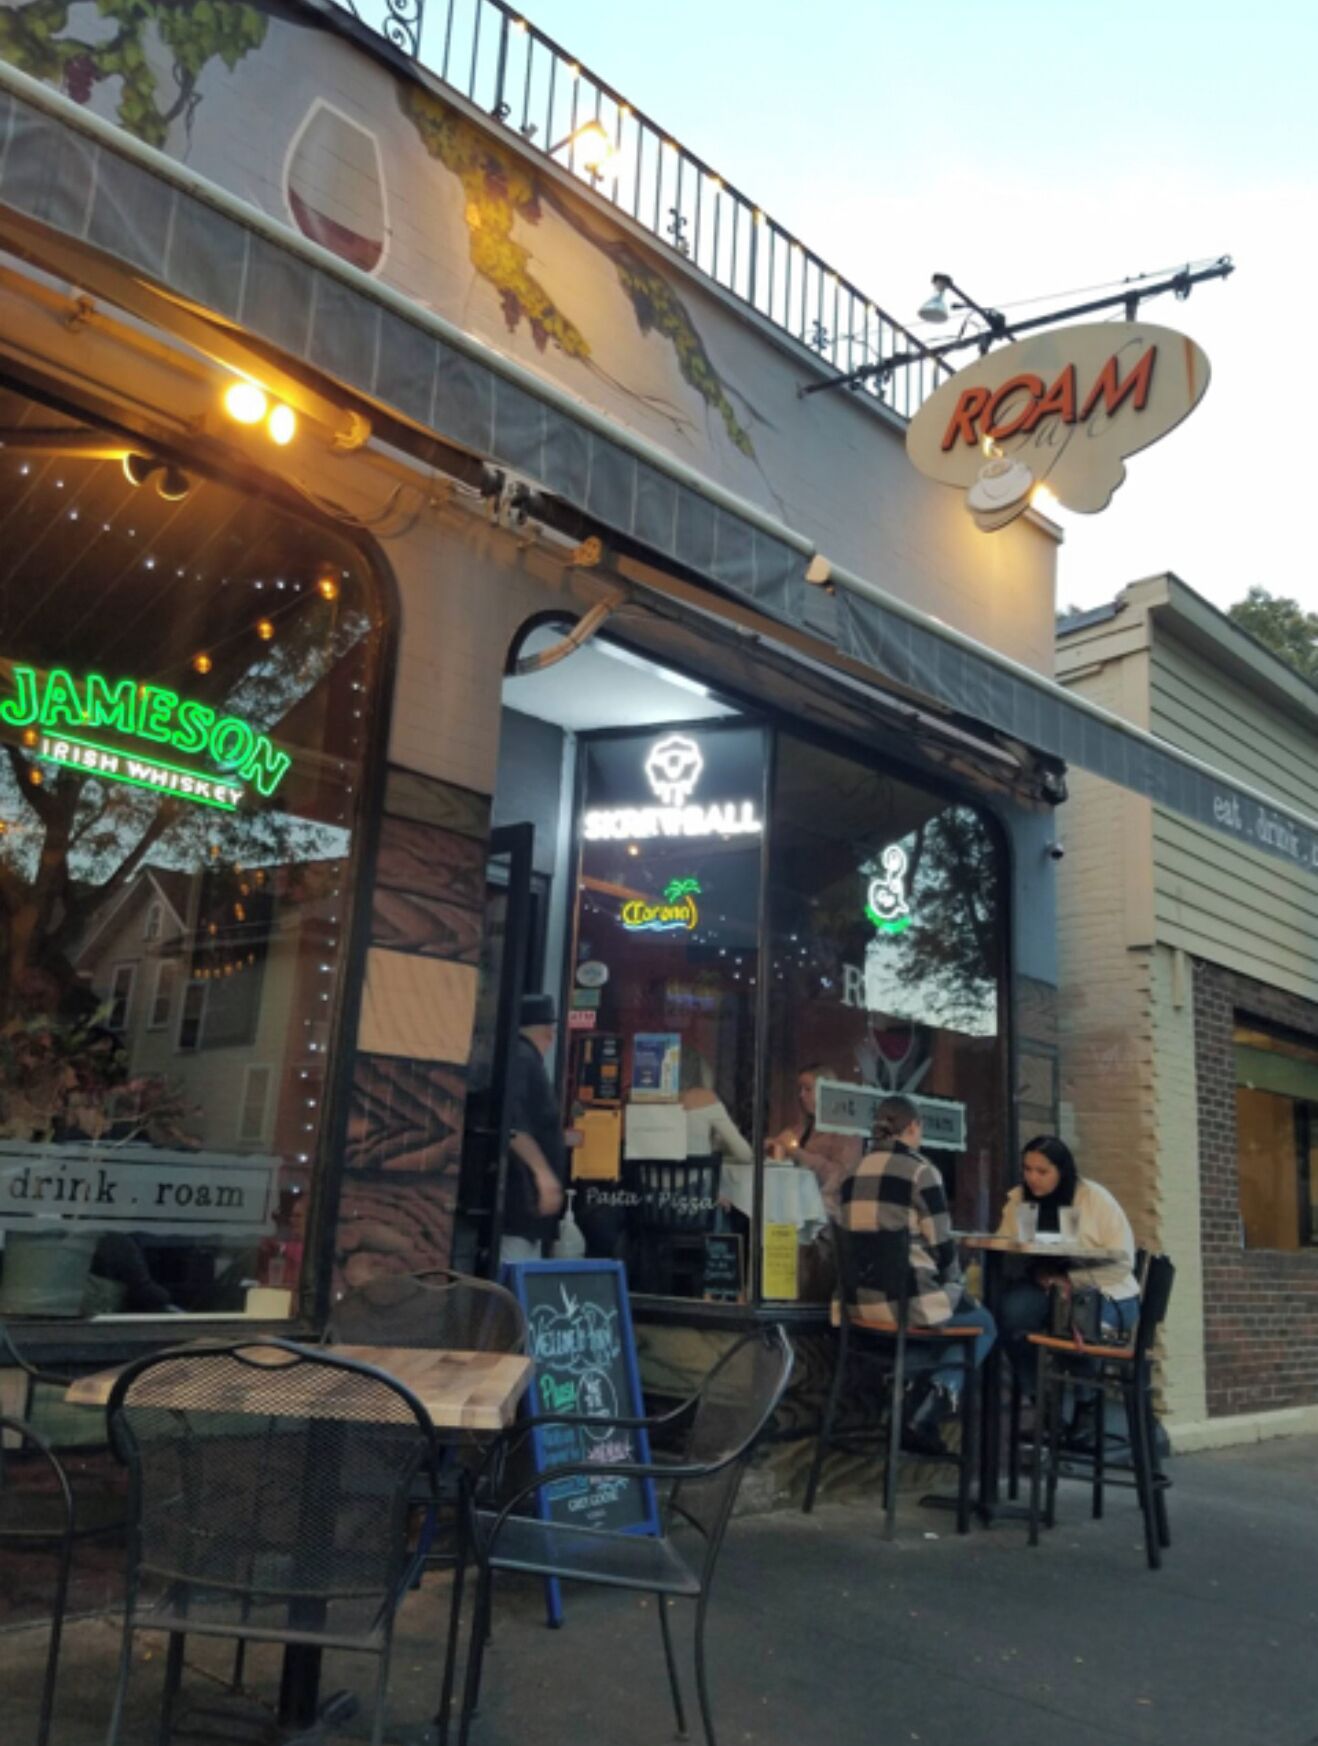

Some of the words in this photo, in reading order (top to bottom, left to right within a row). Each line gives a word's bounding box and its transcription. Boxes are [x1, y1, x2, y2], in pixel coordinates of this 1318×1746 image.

[941, 344, 1157, 453] ROAM
[0, 667, 291, 796] JAMESON
[42, 738, 119, 773] IRISH
[126, 760, 245, 805] WHISKEY
[584, 801, 762, 840] SKRBALL
[1213, 795, 1242, 830] eat
[9, 1164, 117, 1205] drink
[155, 1182, 245, 1208] roam
[586, 1186, 643, 1208] Pasta
[658, 1191, 717, 1217] Pizza
